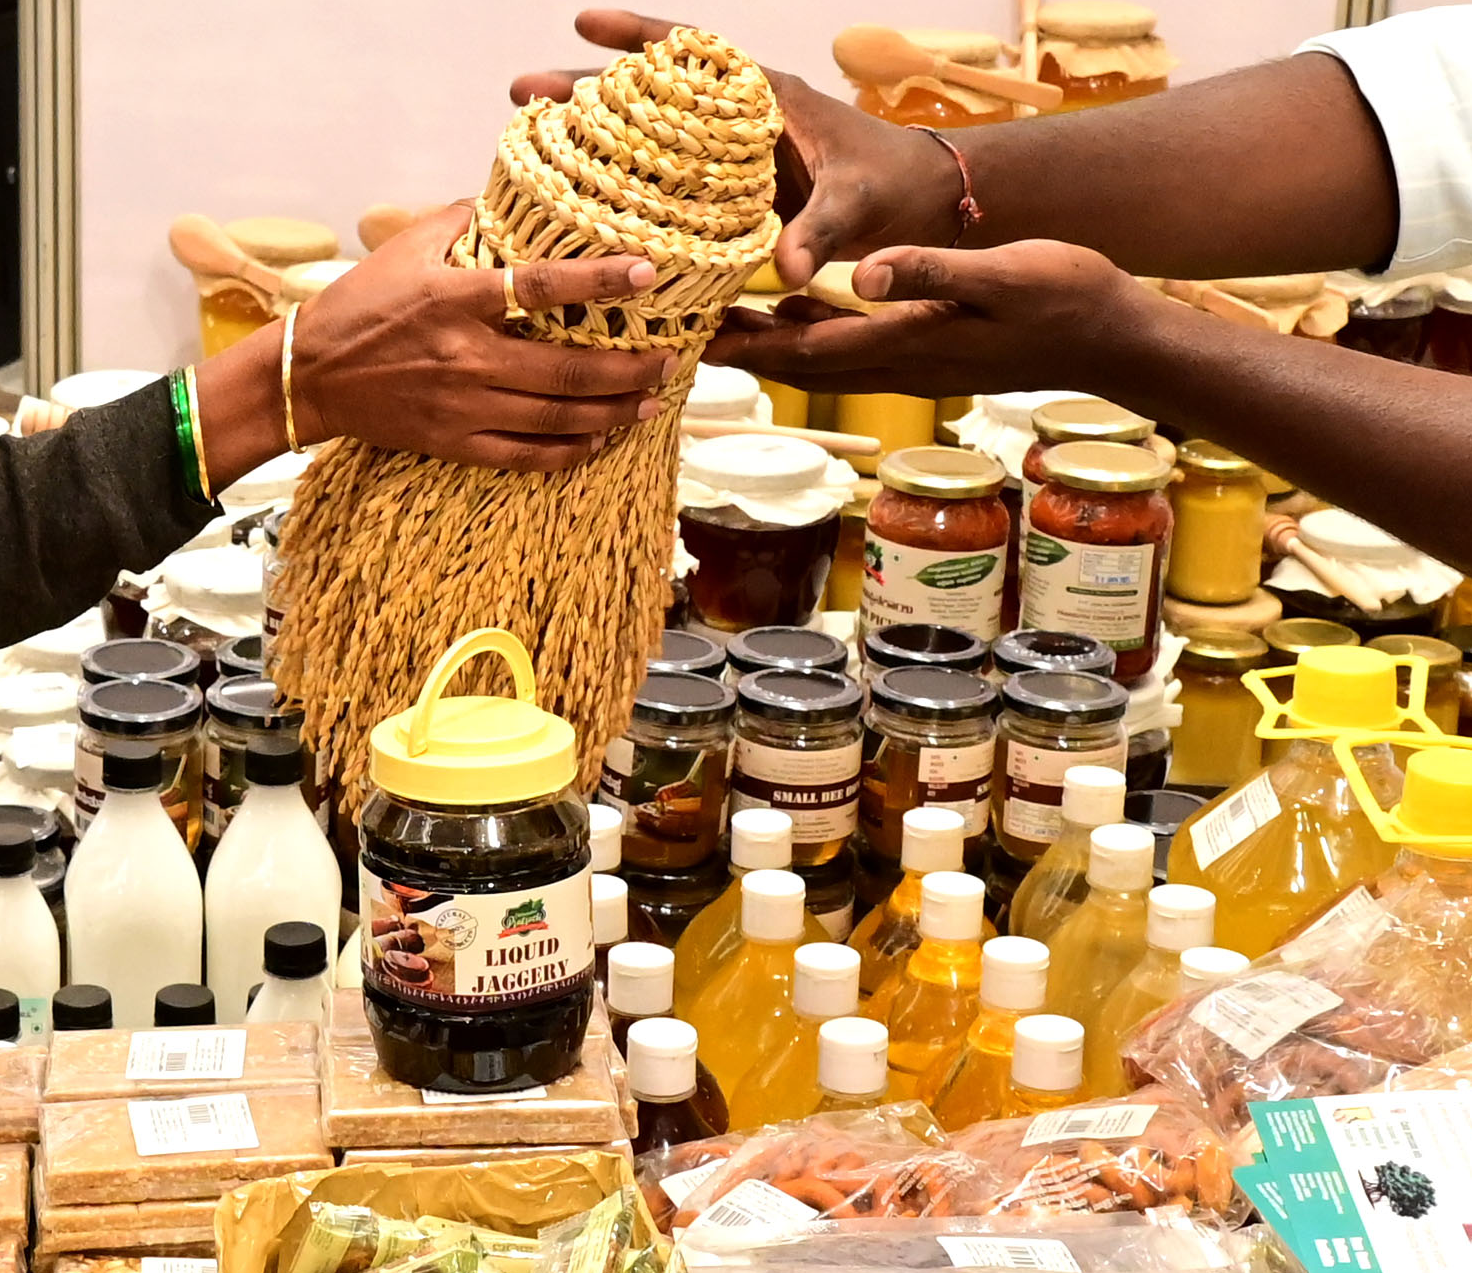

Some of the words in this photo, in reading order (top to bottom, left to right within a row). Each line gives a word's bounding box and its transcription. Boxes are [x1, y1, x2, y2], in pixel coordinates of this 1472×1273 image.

[772, 788, 817, 805] SMALL
[485, 936, 560, 967] LIQUID
[471, 958, 570, 994] JAGGERY
